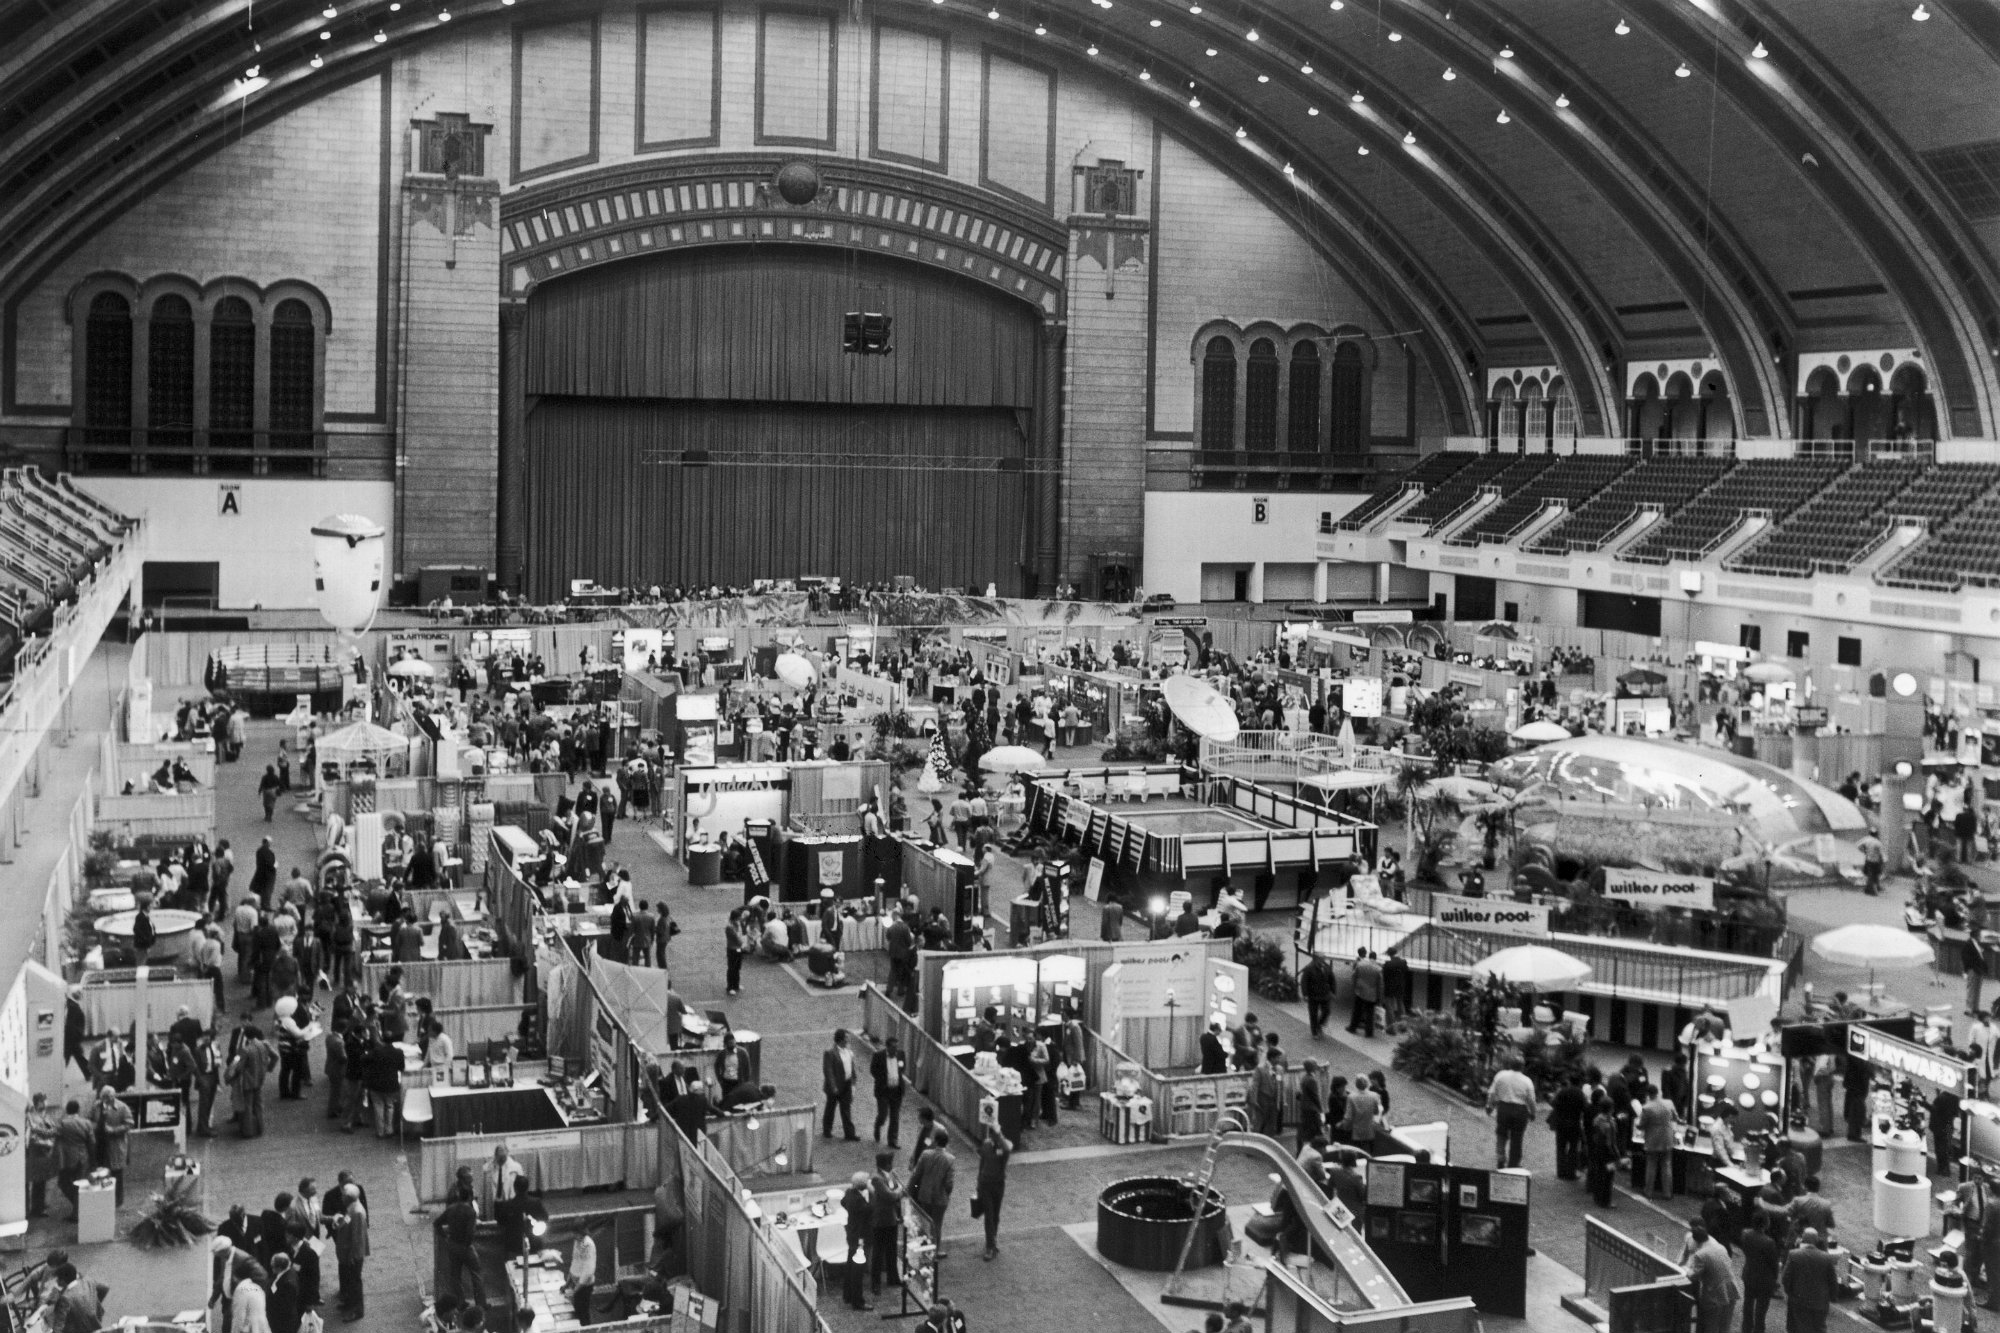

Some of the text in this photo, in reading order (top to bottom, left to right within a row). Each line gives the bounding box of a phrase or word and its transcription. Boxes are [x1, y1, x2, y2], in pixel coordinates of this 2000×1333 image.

[222, 492, 238, 514] A
[1255, 503, 1266, 522] B
[391, 633, 450, 641] SOLARTRONICS
[1610, 881, 1658, 894] wilkes
[1441, 908, 1490, 922] wilkes
[1120, 956, 1145, 964] wilkes
[1869, 1038, 1957, 1088] HAYWARD
